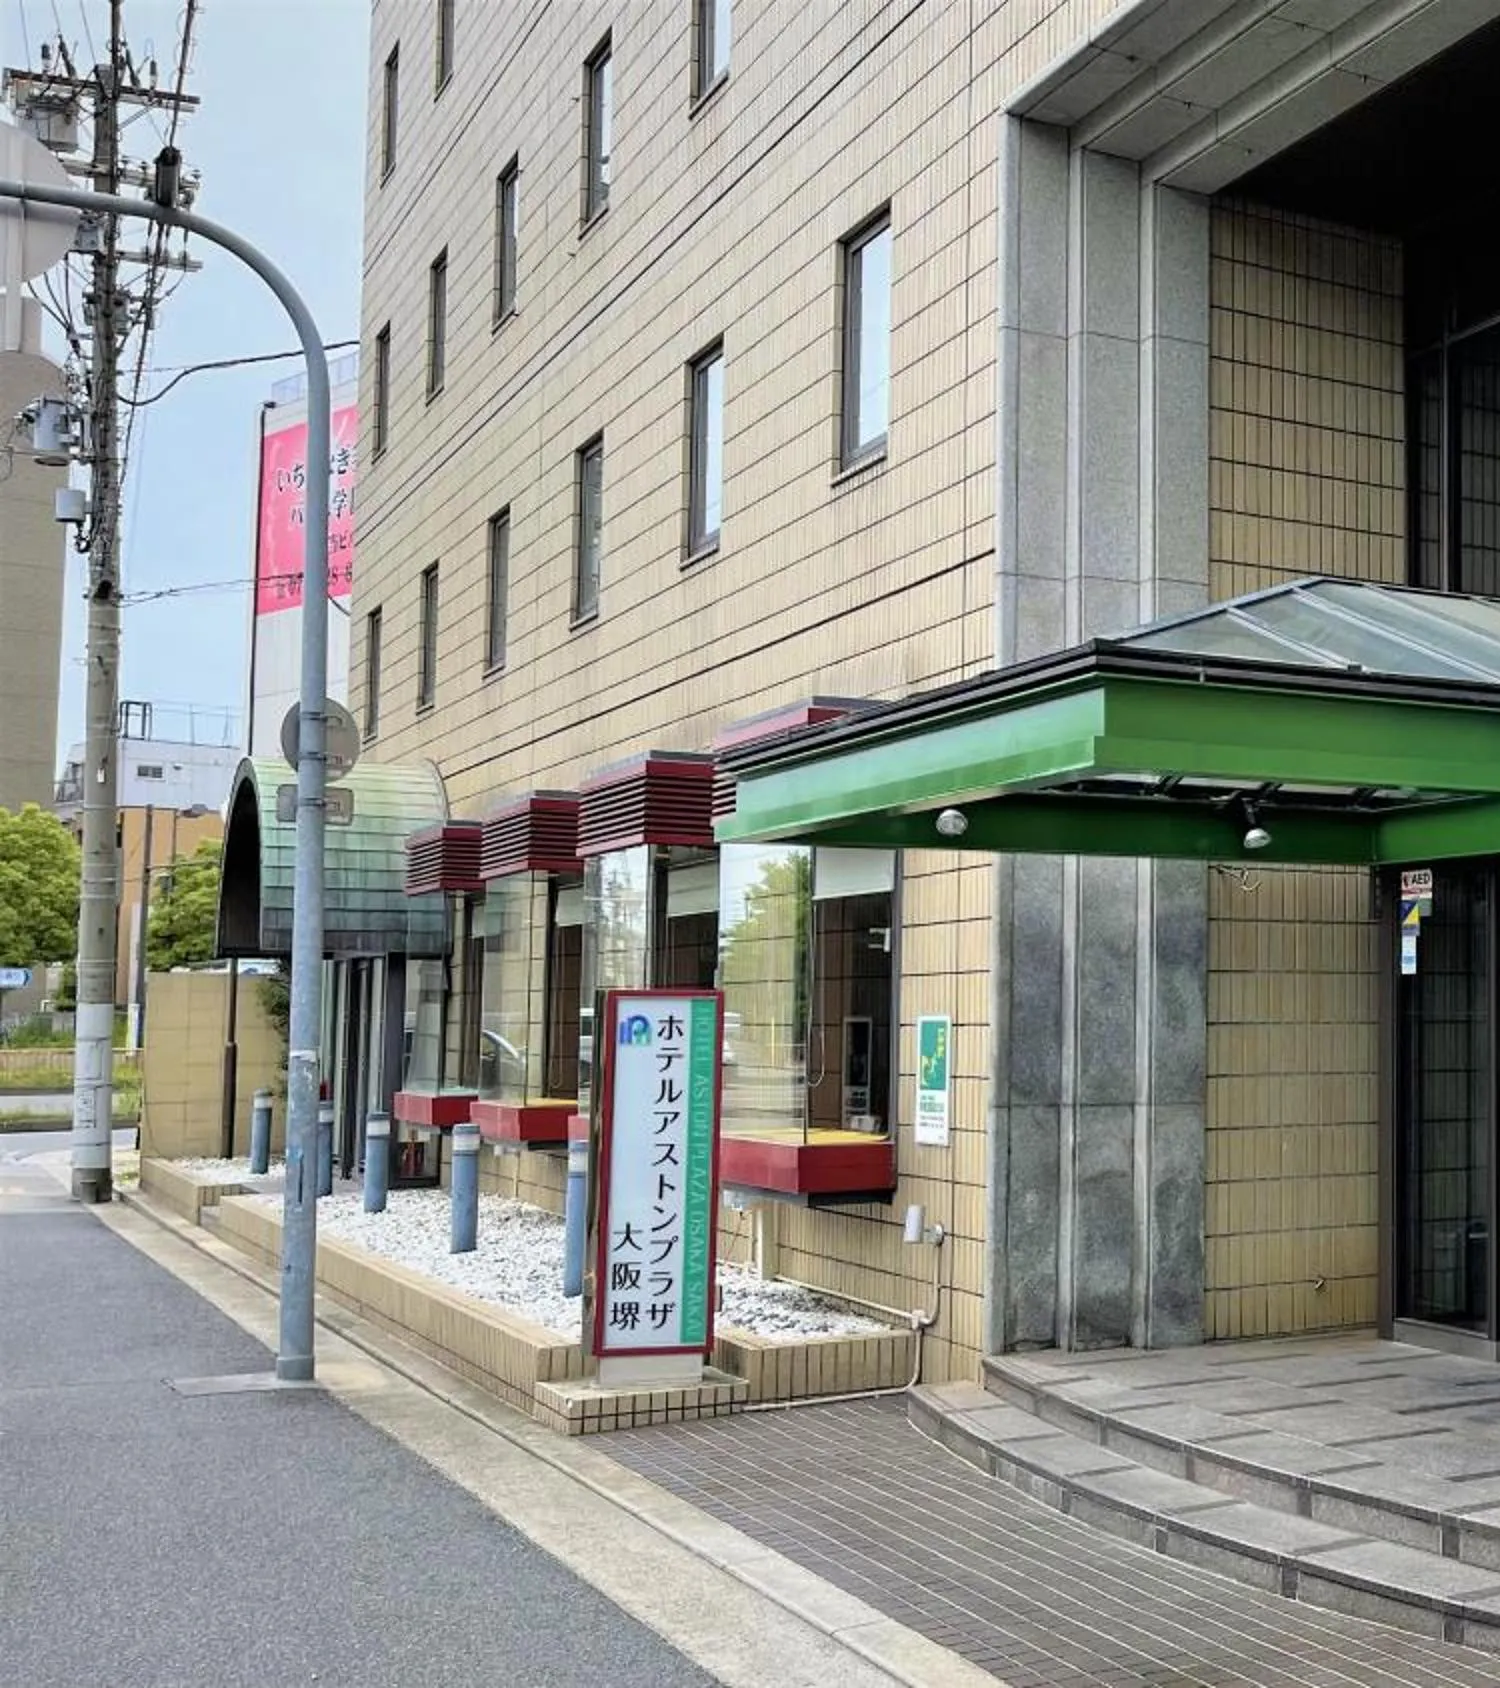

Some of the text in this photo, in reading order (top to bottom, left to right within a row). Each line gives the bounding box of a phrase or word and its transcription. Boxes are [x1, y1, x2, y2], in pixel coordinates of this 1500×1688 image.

[1411, 872, 1431, 885] AED
[692, 1074, 711, 1137] ASTON
[646, 1015, 685, 1331] ホテルアストンプラザ
[690, 1143, 709, 1204] PLAZA
[687, 1210, 706, 1275] OSAKA
[609, 1222, 644, 1331] 大阪堺
[686, 1281, 704, 1337] SAKAI
